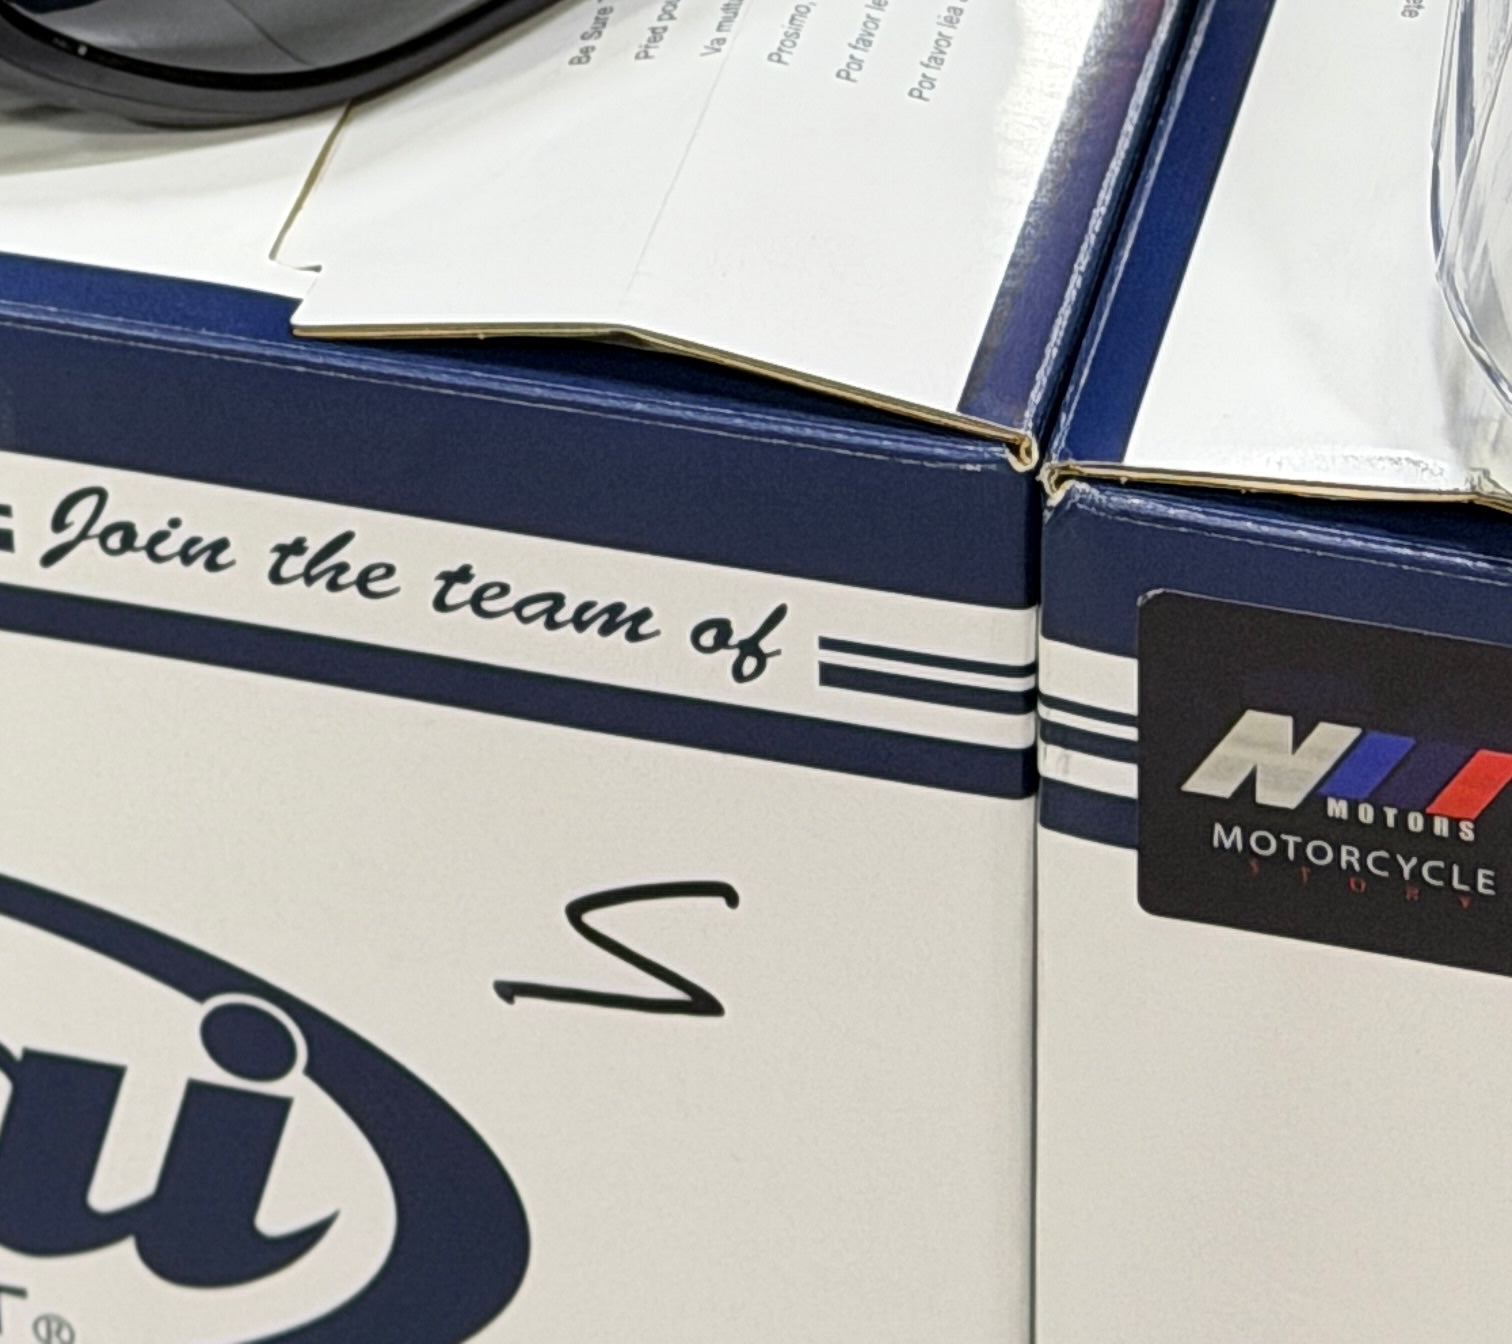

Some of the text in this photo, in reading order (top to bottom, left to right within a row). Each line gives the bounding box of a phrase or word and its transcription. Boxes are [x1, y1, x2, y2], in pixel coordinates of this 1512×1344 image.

[580, 6, 614, 40] Sure
[767, 2, 816, 65] Prosimo,
[848, 14, 880, 52] favor
[568, 46, 596, 65] Be
[700, 37, 727, 56] Va
[920, 31, 952, 70] favor
[836, 54, 864, 82] Por
[908, 73, 936, 101] Por
[39, 486, 790, 683] Join the team of
[1326, 796, 1475, 842] MOTORS
[1212, 822, 1497, 897] MOTORCYCLE
